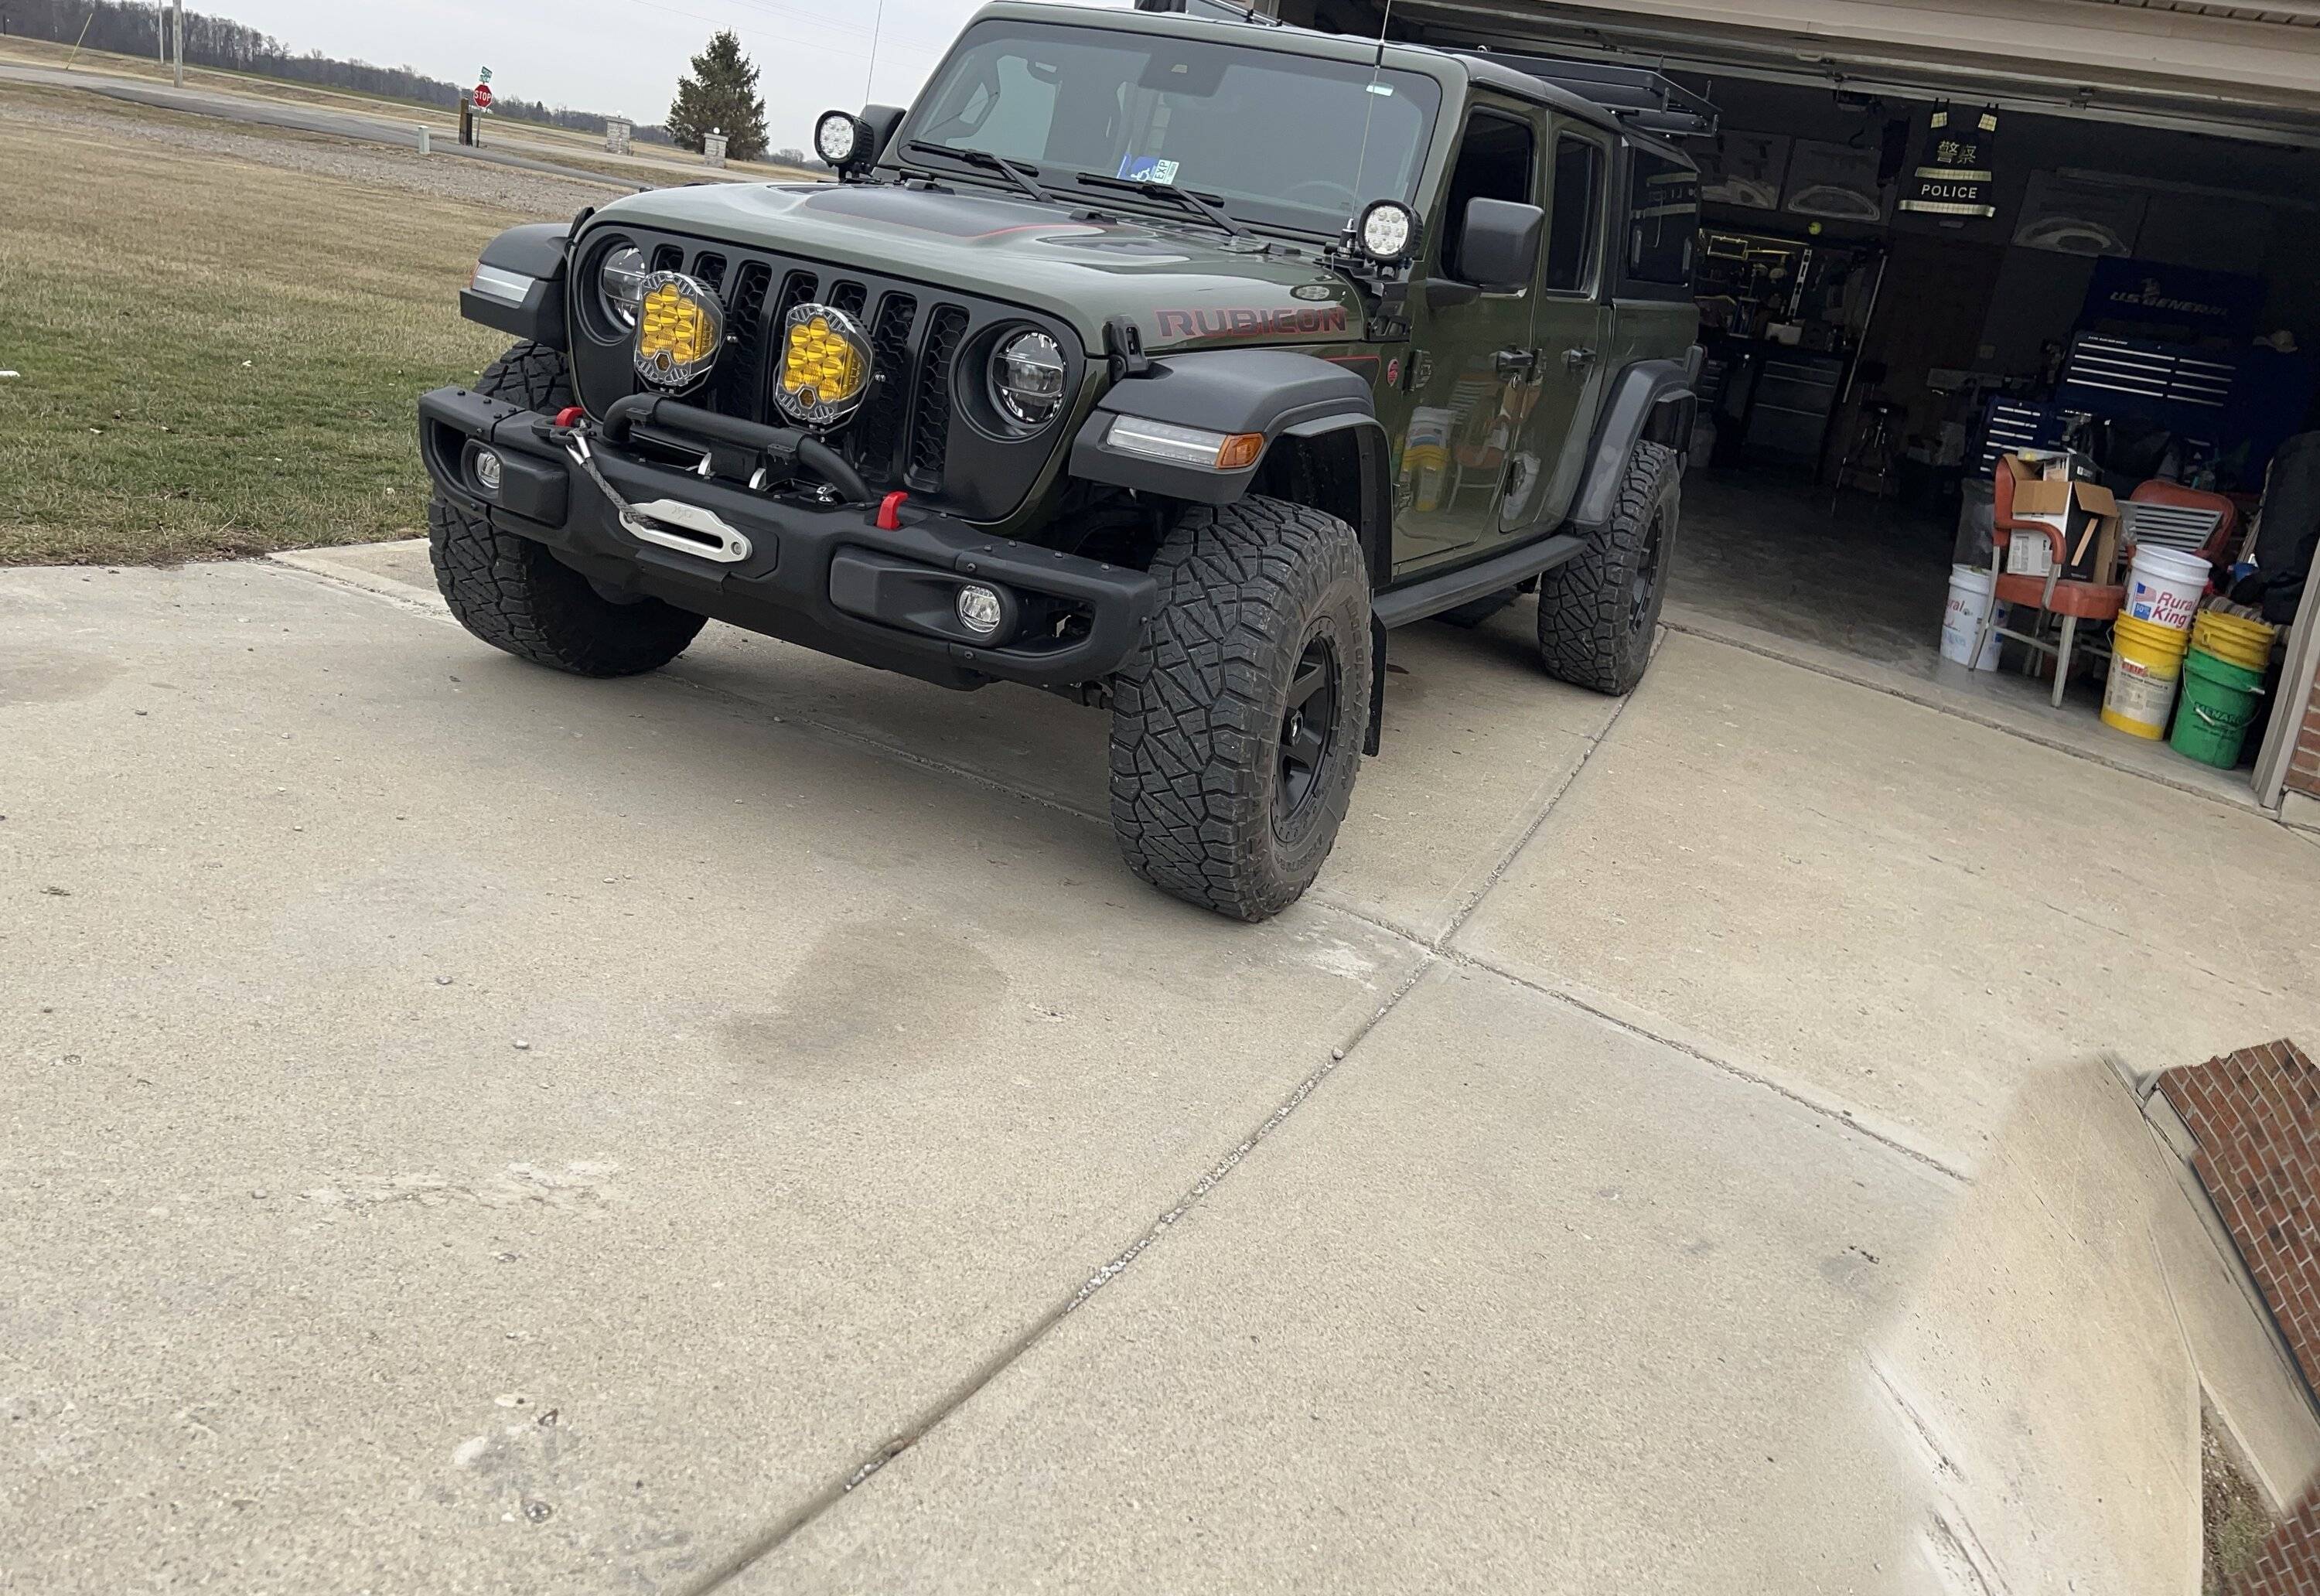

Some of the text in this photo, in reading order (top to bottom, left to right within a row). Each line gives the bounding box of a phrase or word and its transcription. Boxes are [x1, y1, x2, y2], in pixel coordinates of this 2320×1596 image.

[474, 90, 492, 101] STOP
[1155, 161, 1168, 179] EXP
[1921, 184, 1978, 199] POLICE
[1155, 306, 1349, 338] RUBICON
[2158, 591, 2197, 612] Rural
[2152, 605, 2188, 629] King
